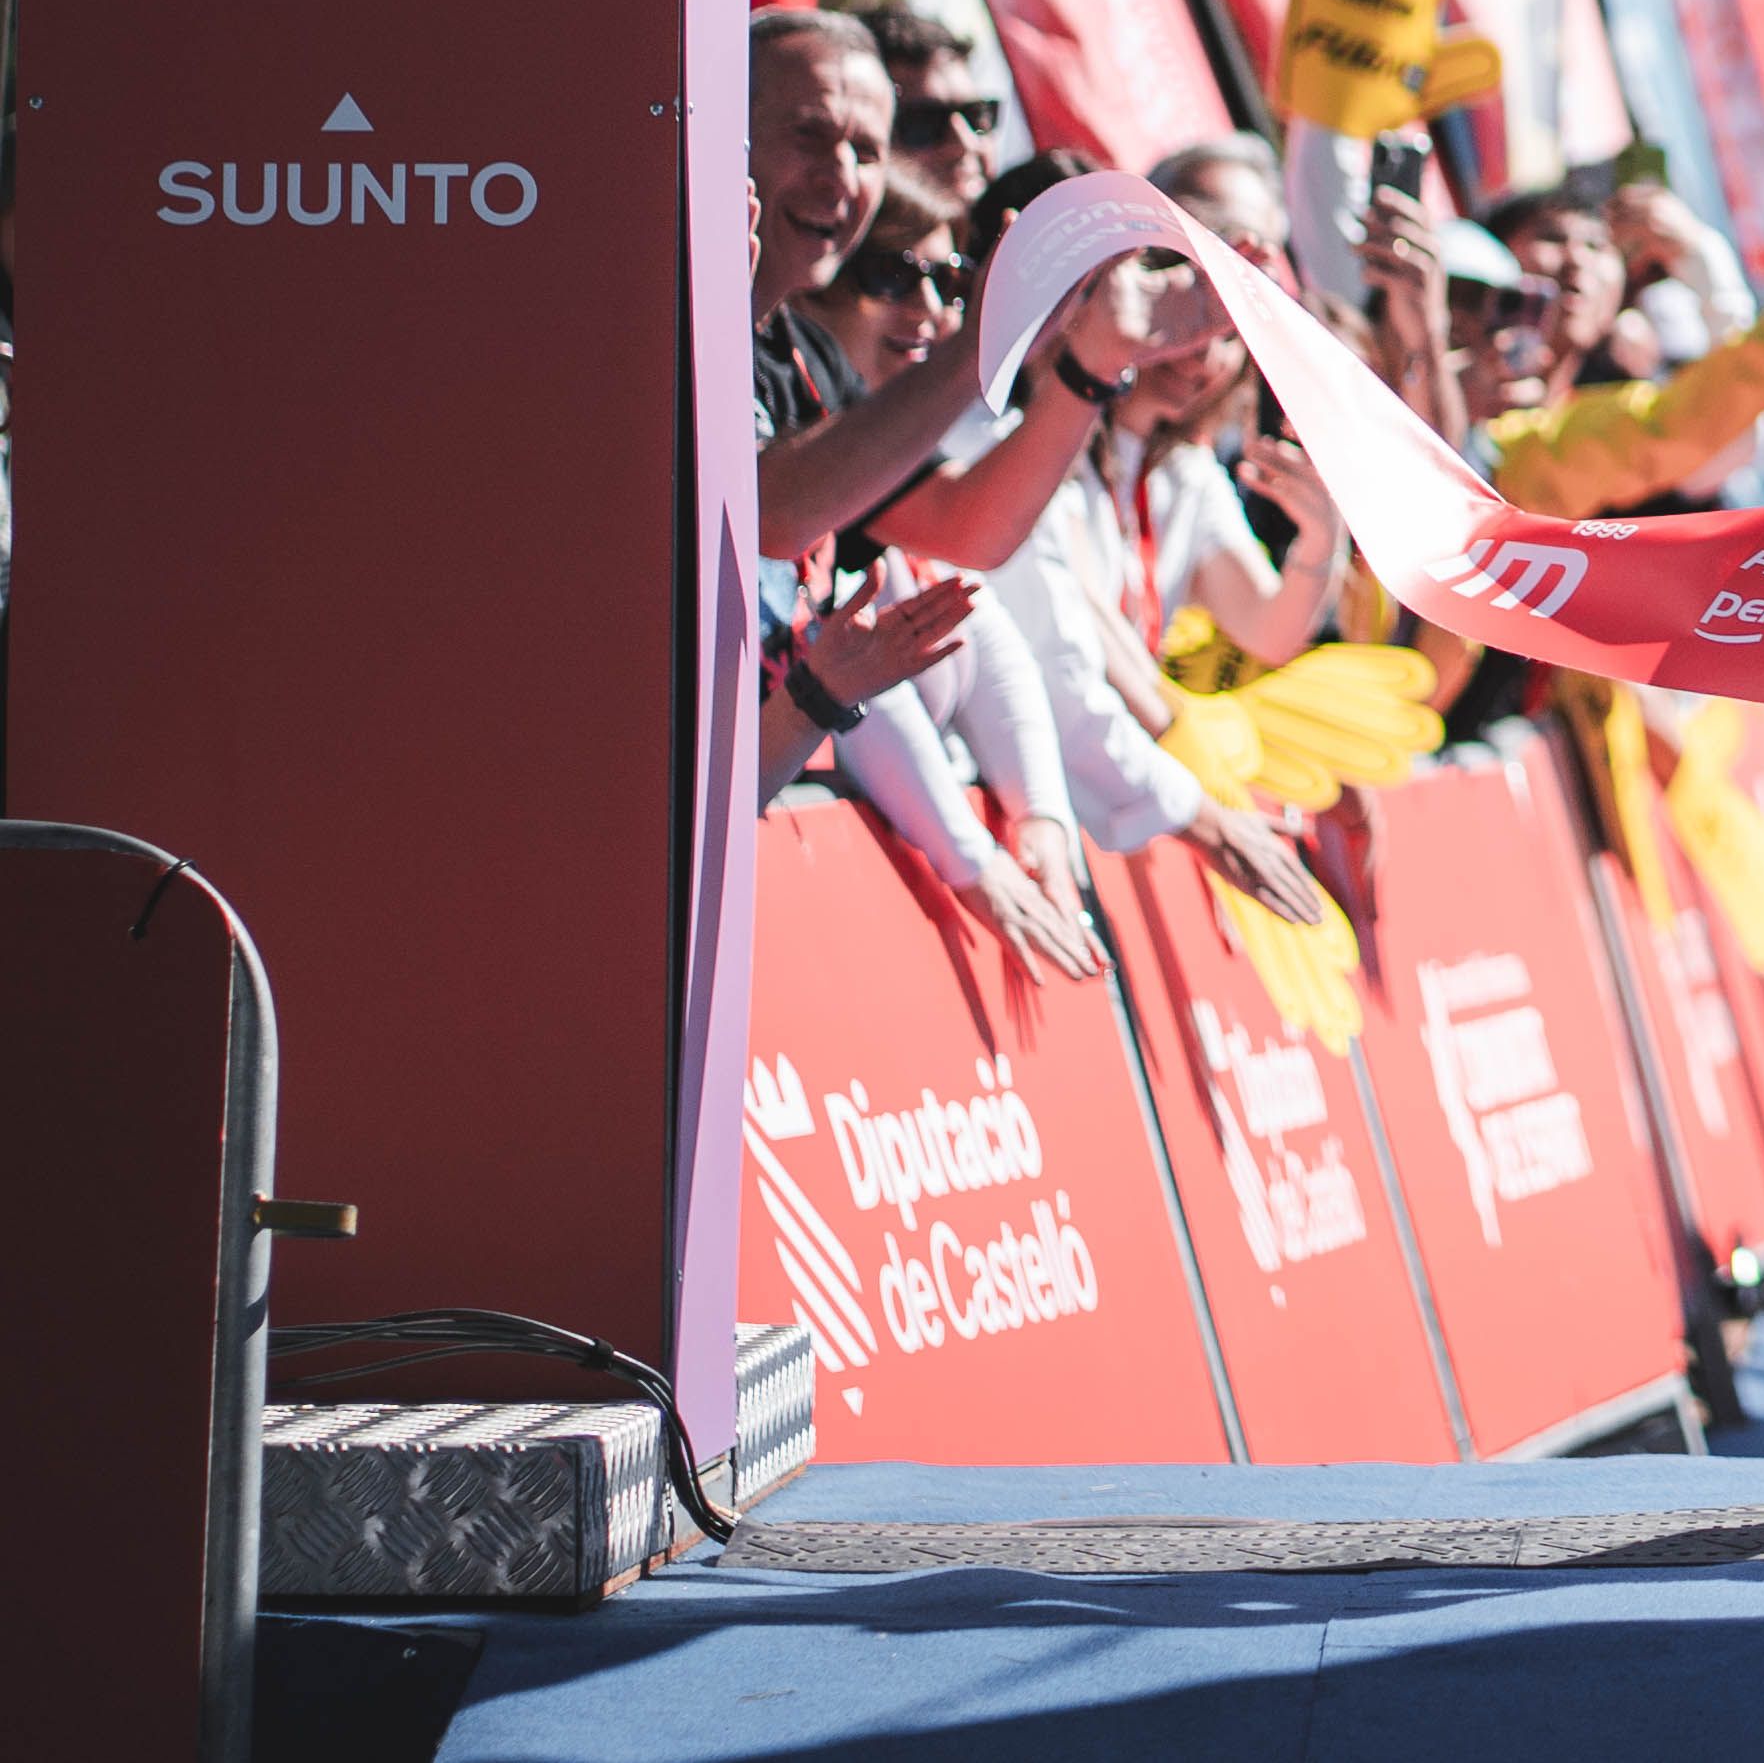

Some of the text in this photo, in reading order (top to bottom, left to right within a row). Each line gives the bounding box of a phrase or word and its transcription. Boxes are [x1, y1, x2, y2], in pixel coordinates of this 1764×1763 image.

[157, 161, 538, 226] SUUNTO
[1571, 519, 1640, 541] 1999
[824, 1052, 1043, 1232] Diputació
[877, 1226, 944, 1355] de
[930, 1190, 1100, 1342] Castelló
